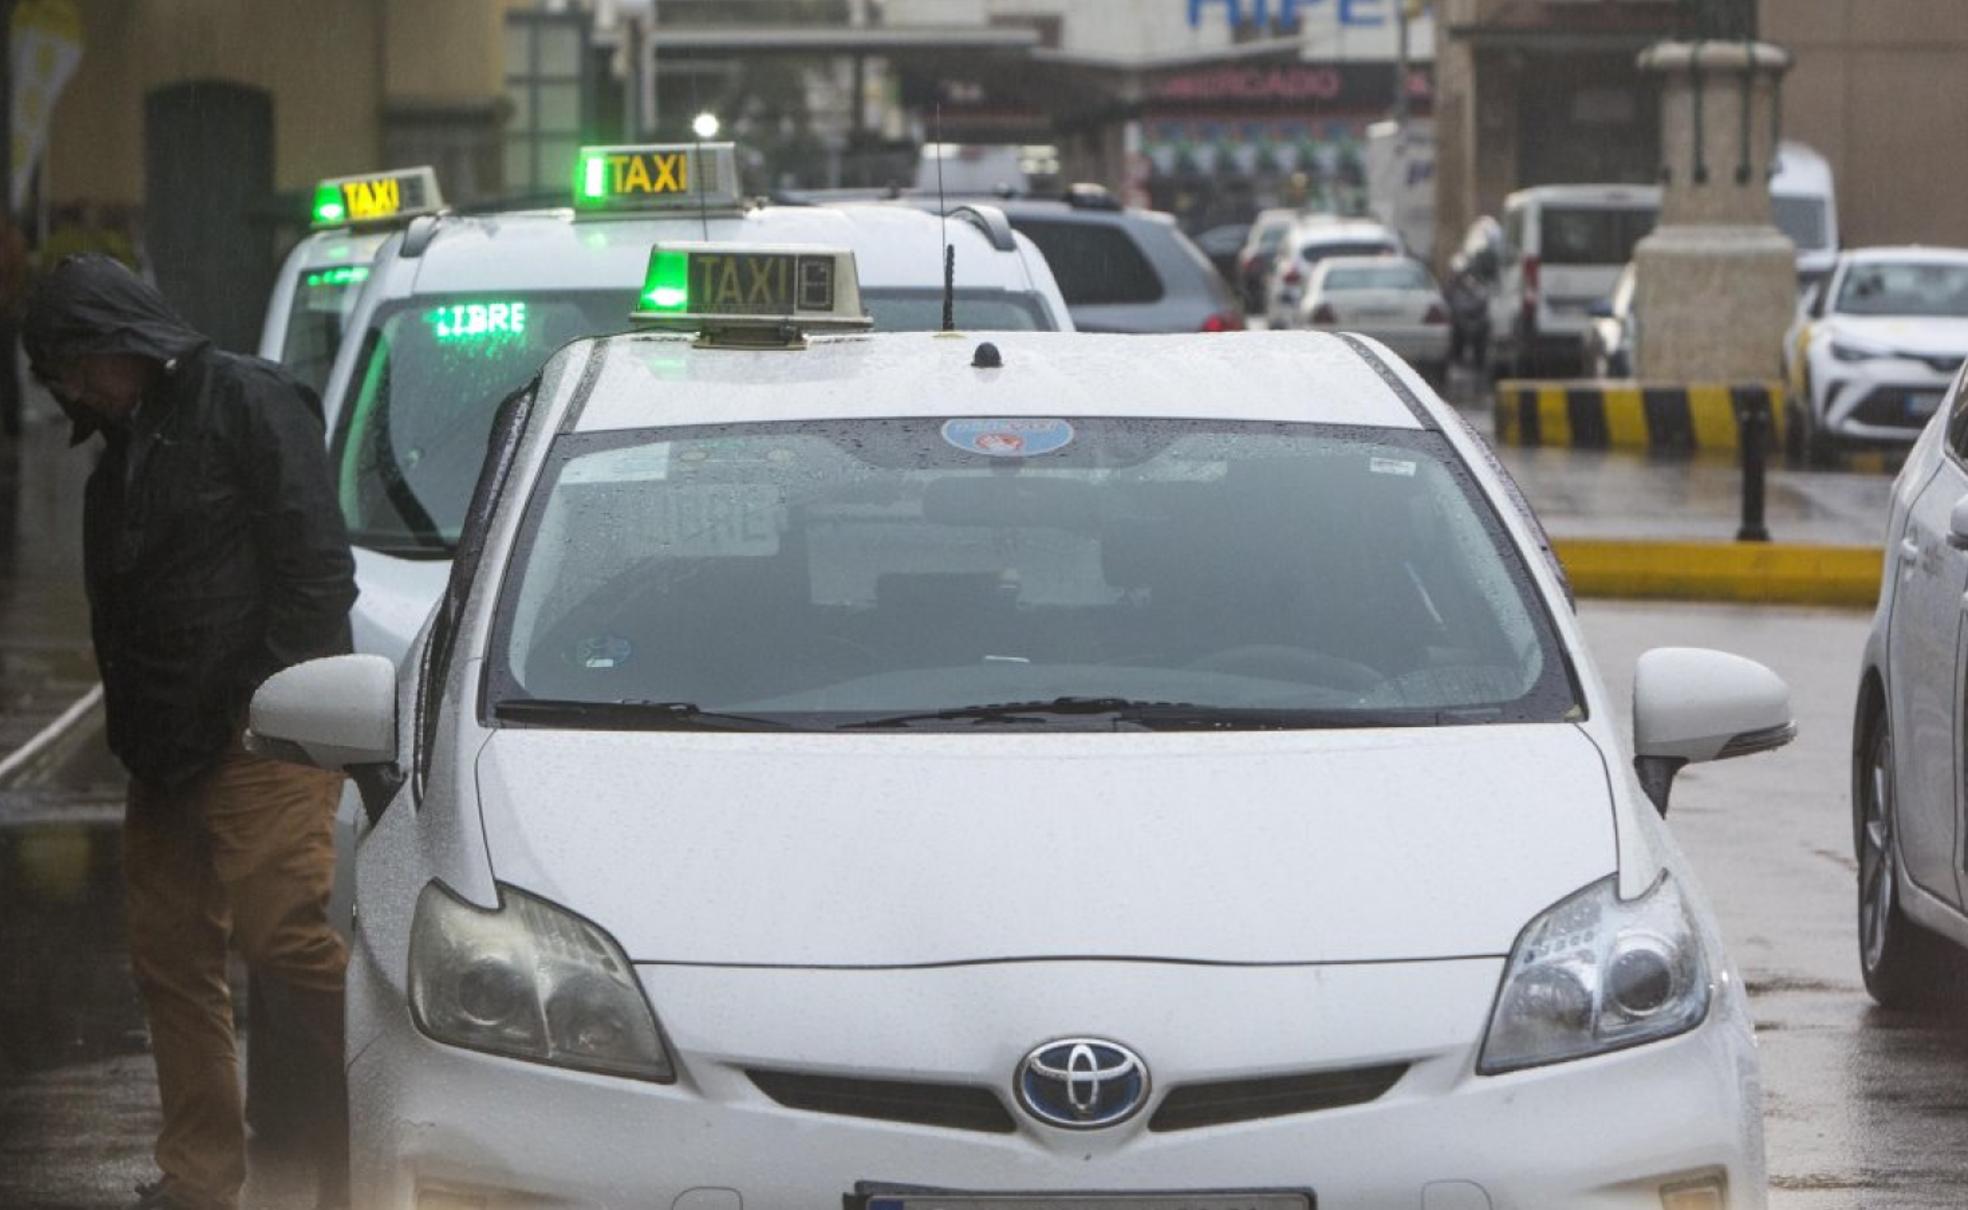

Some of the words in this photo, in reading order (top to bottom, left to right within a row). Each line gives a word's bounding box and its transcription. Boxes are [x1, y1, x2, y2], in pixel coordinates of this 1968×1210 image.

[611, 152, 688, 193] TAXI
[343, 177, 400, 220] TAXI
[697, 256, 787, 304] TAXI
[436, 302, 526, 337] LIBRE
